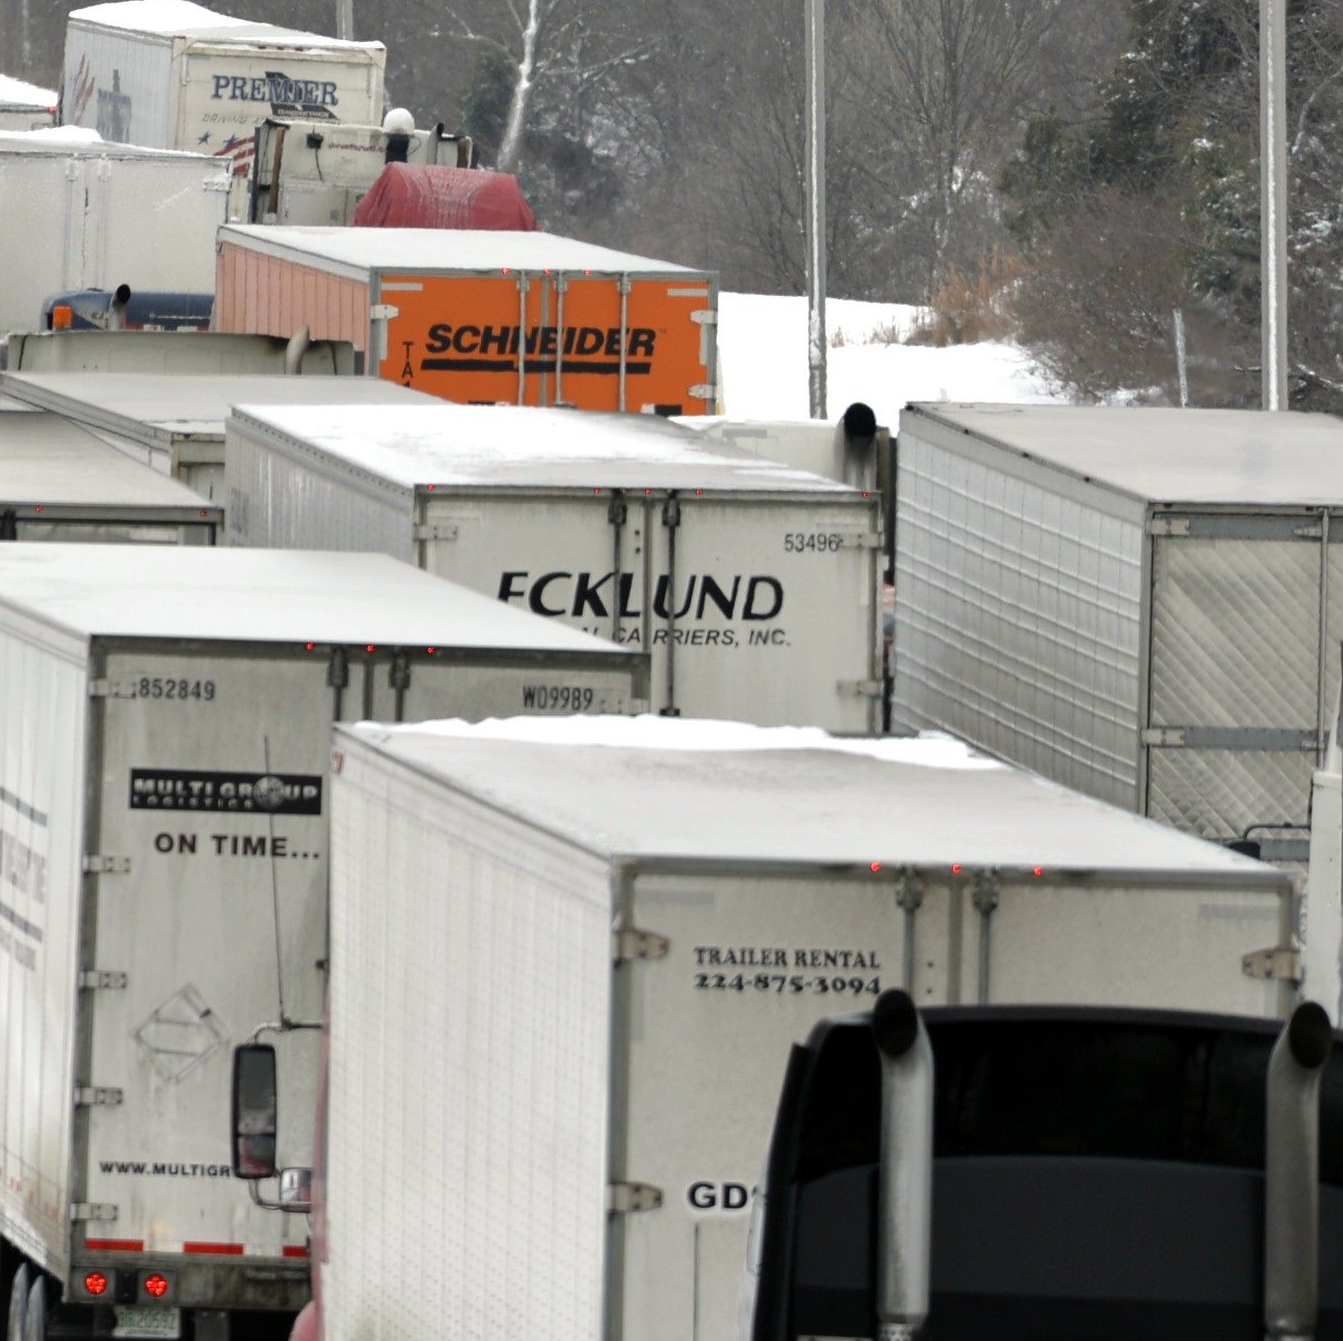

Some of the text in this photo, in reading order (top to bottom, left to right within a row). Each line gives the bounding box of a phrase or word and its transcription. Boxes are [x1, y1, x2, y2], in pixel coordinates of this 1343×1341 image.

[211, 74, 339, 106] PREMIER
[425, 323, 657, 357] SCHNEIDER
[784, 533, 840, 553] 53496
[498, 571, 784, 621] ECKLUND
[748, 629, 792, 647] INC.
[138, 677, 216, 701] 852849
[521, 686, 594, 710] W09989
[133, 777, 214, 797] MULTI
[132, 794, 254, 809] LOGISTICS
[154, 832, 320, 859] ON TIME...
[693, 945, 881, 970] TRAILER RENTAL
[694, 971, 882, 996] 224-875-3094
[99, 1161, 234, 1177] WWW.MULTIGR
[687, 1180, 759, 1210] GD
